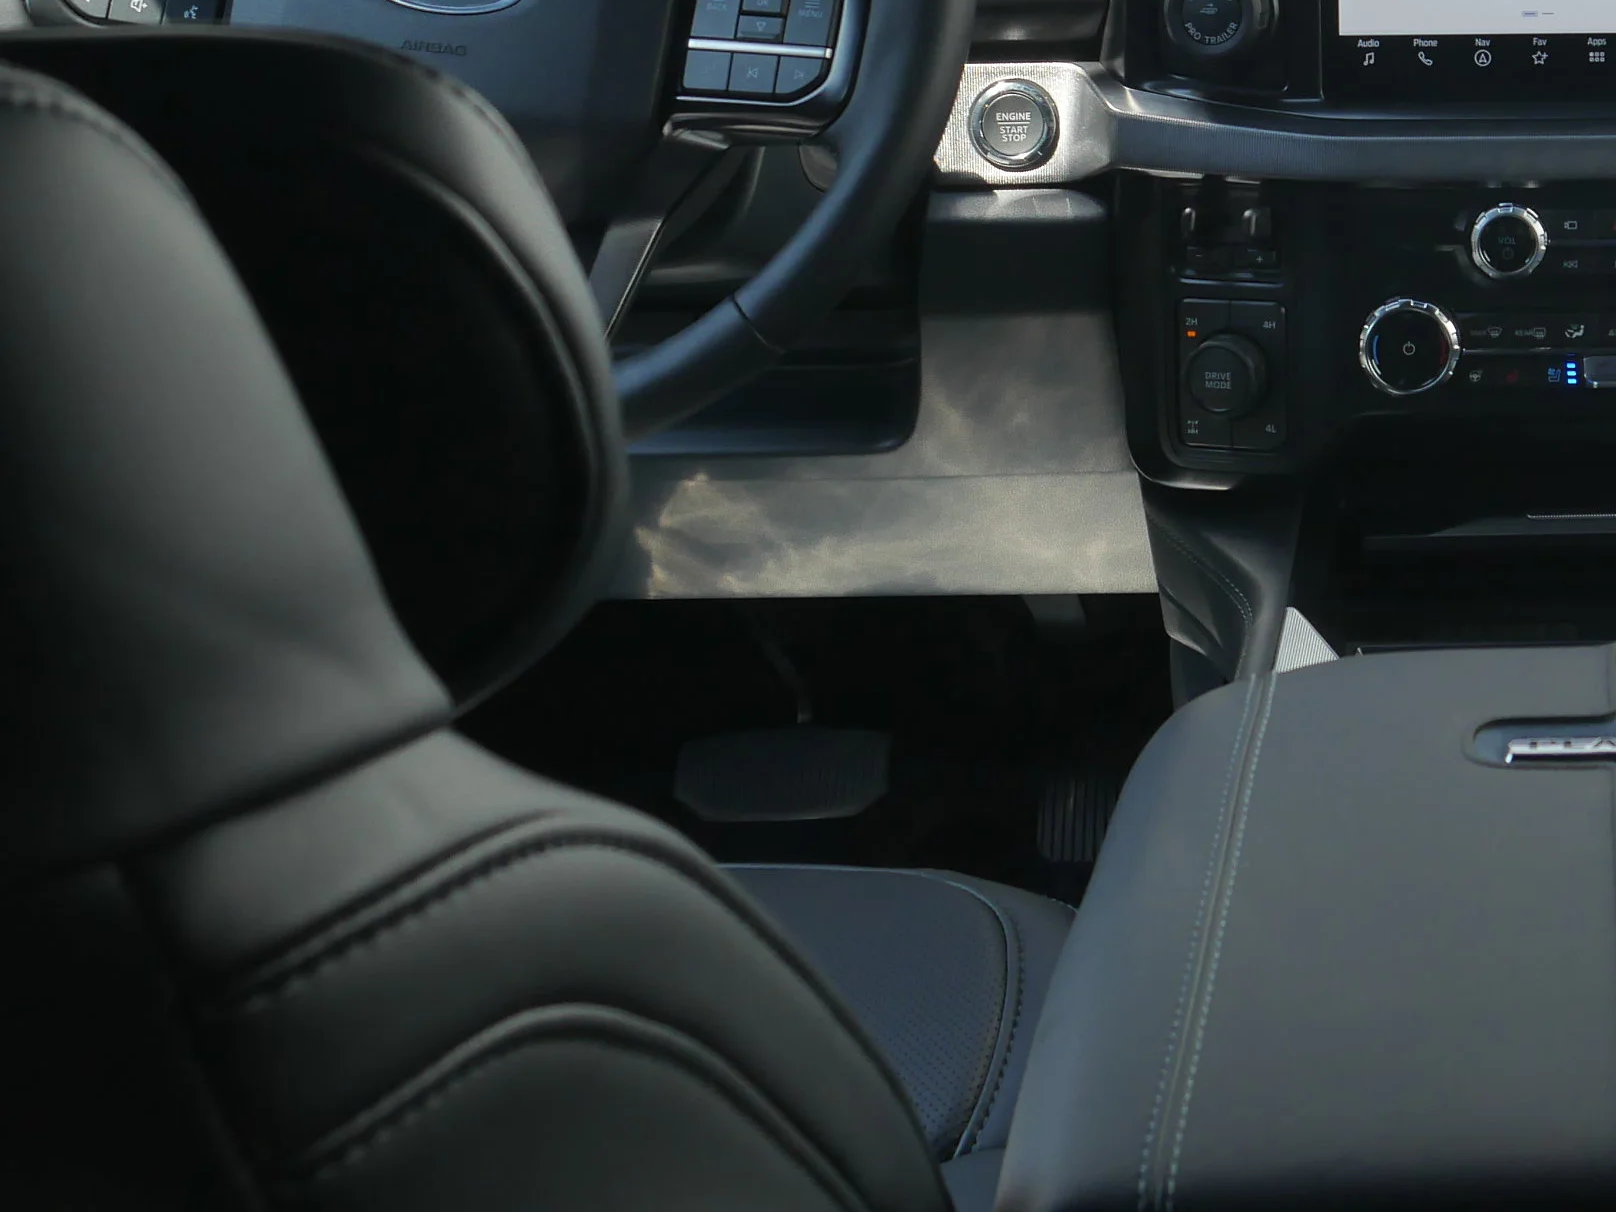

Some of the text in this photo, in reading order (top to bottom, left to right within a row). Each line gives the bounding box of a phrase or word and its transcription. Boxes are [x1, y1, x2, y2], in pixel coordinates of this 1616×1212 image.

[1204, 22, 1238, 44] TRAILER
[1357, 39, 1379, 48] Audio
[1413, 38, 1438, 48] Phone
[1475, 38, 1490, 47] Nav
[1533, 37, 1547, 46] Fav
[1587, 37, 1606, 48] Apps
[401, 40, 467, 57] AIRBAG
[996, 112, 1031, 121] ENGINE
[1000, 126, 1028, 134] START
[1002, 134, 1027, 142] STOP
[1185, 317, 1198, 326] 2H
[1262, 321, 1276, 329] 4H
[1205, 371, 1231, 381] DRIVE
[1205, 380, 1232, 390] MODE
[1265, 423, 1277, 434] 4L
